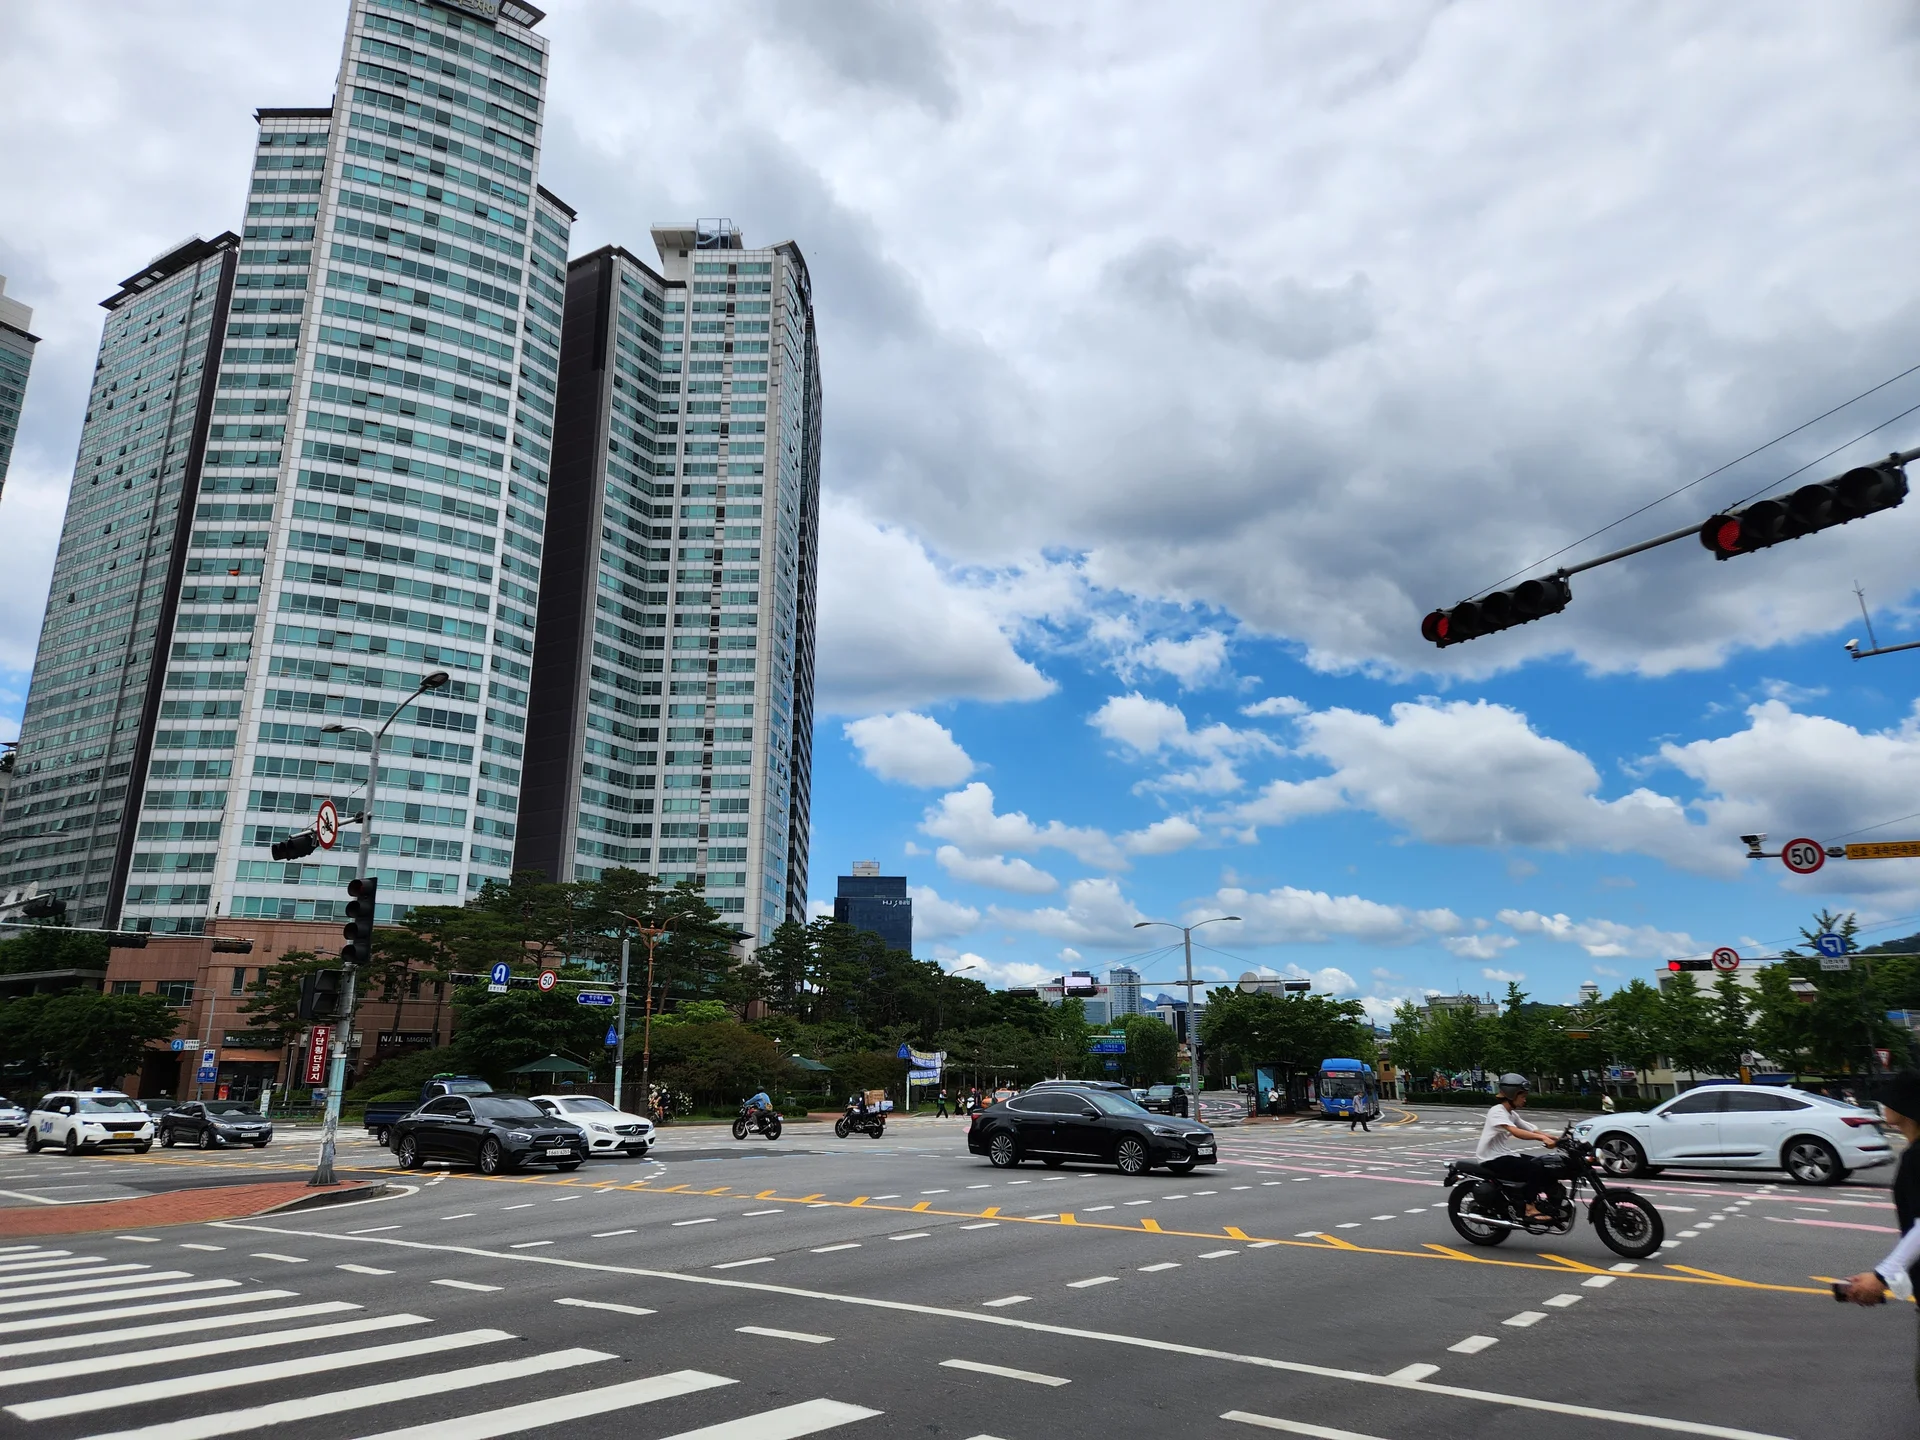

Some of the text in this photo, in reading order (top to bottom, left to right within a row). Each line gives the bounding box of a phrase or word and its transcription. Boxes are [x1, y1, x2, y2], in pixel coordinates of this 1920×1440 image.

[458, 0, 499, 18] 크자이
[1791, 846, 1816, 866] 50
[542, 976, 553, 986] 50
[310, 1028, 326, 1081] 무단횡단금지
